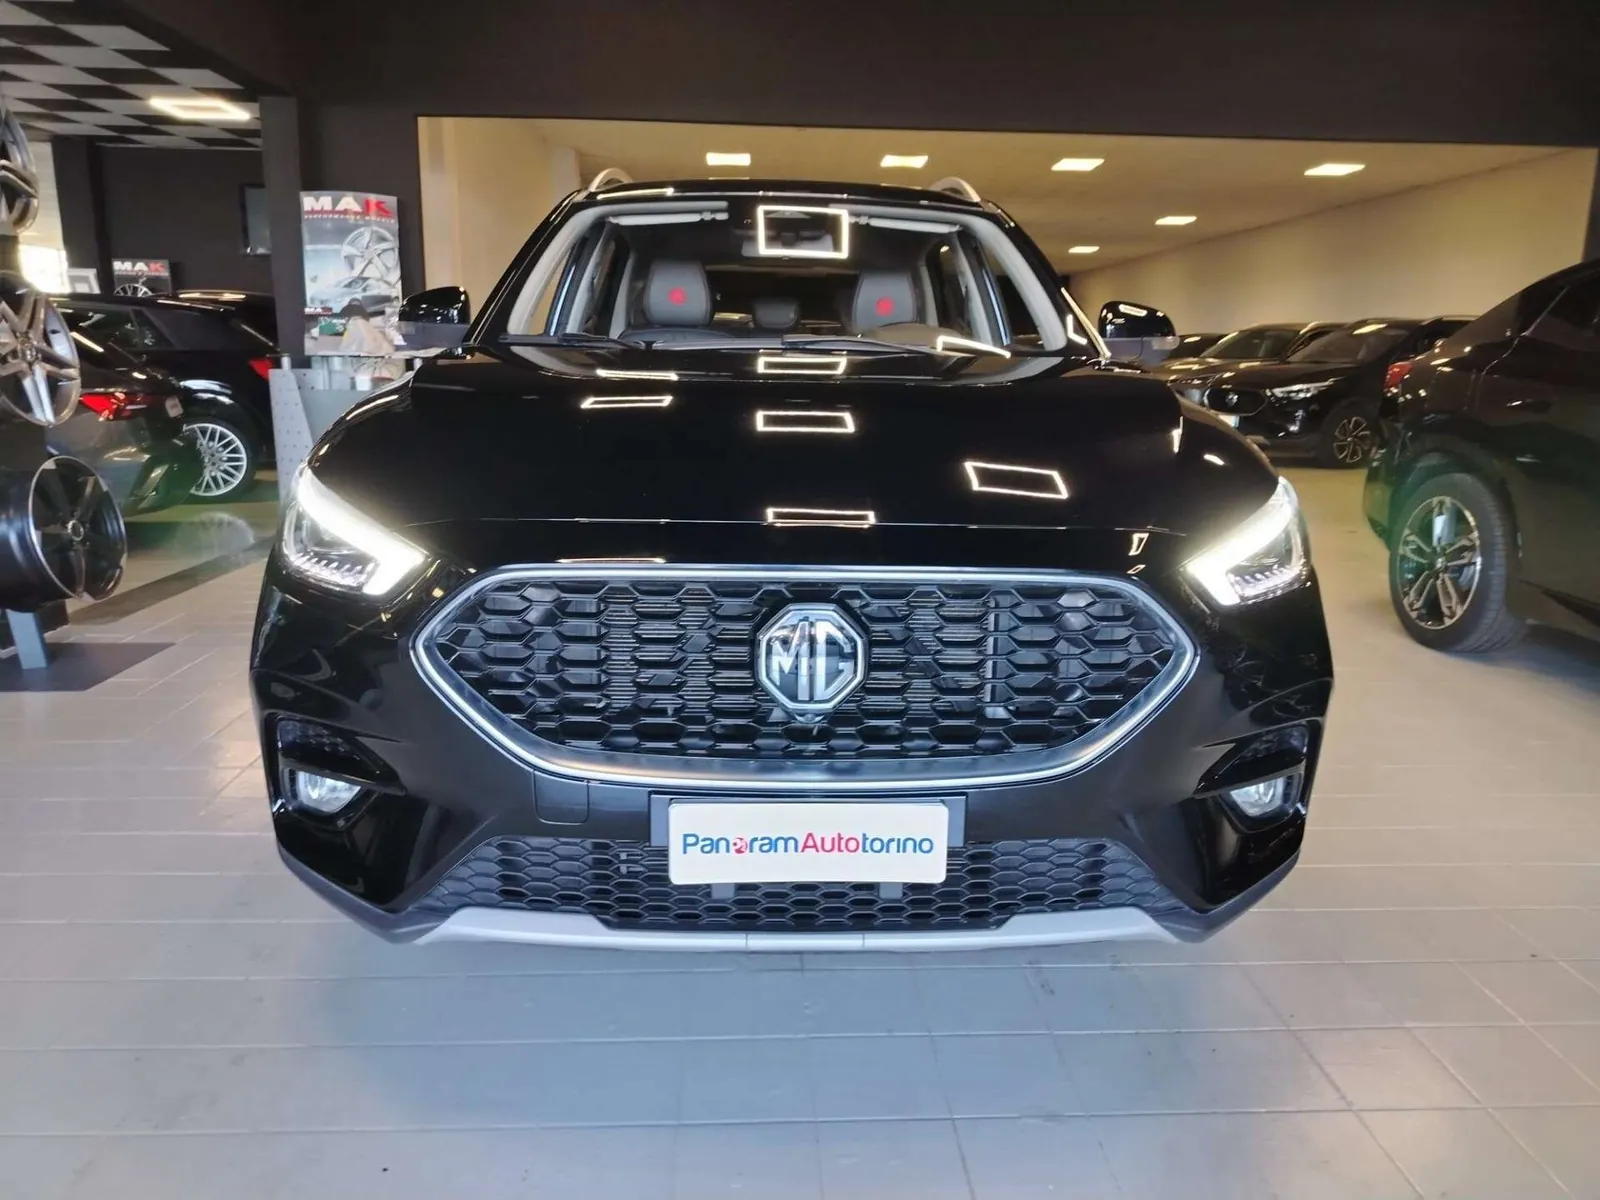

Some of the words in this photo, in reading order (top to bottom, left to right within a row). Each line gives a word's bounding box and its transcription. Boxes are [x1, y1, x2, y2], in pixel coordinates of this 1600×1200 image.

[303, 196, 392, 217] MAK
[113, 261, 165, 272] MAK
[770, 621, 855, 701] MG
